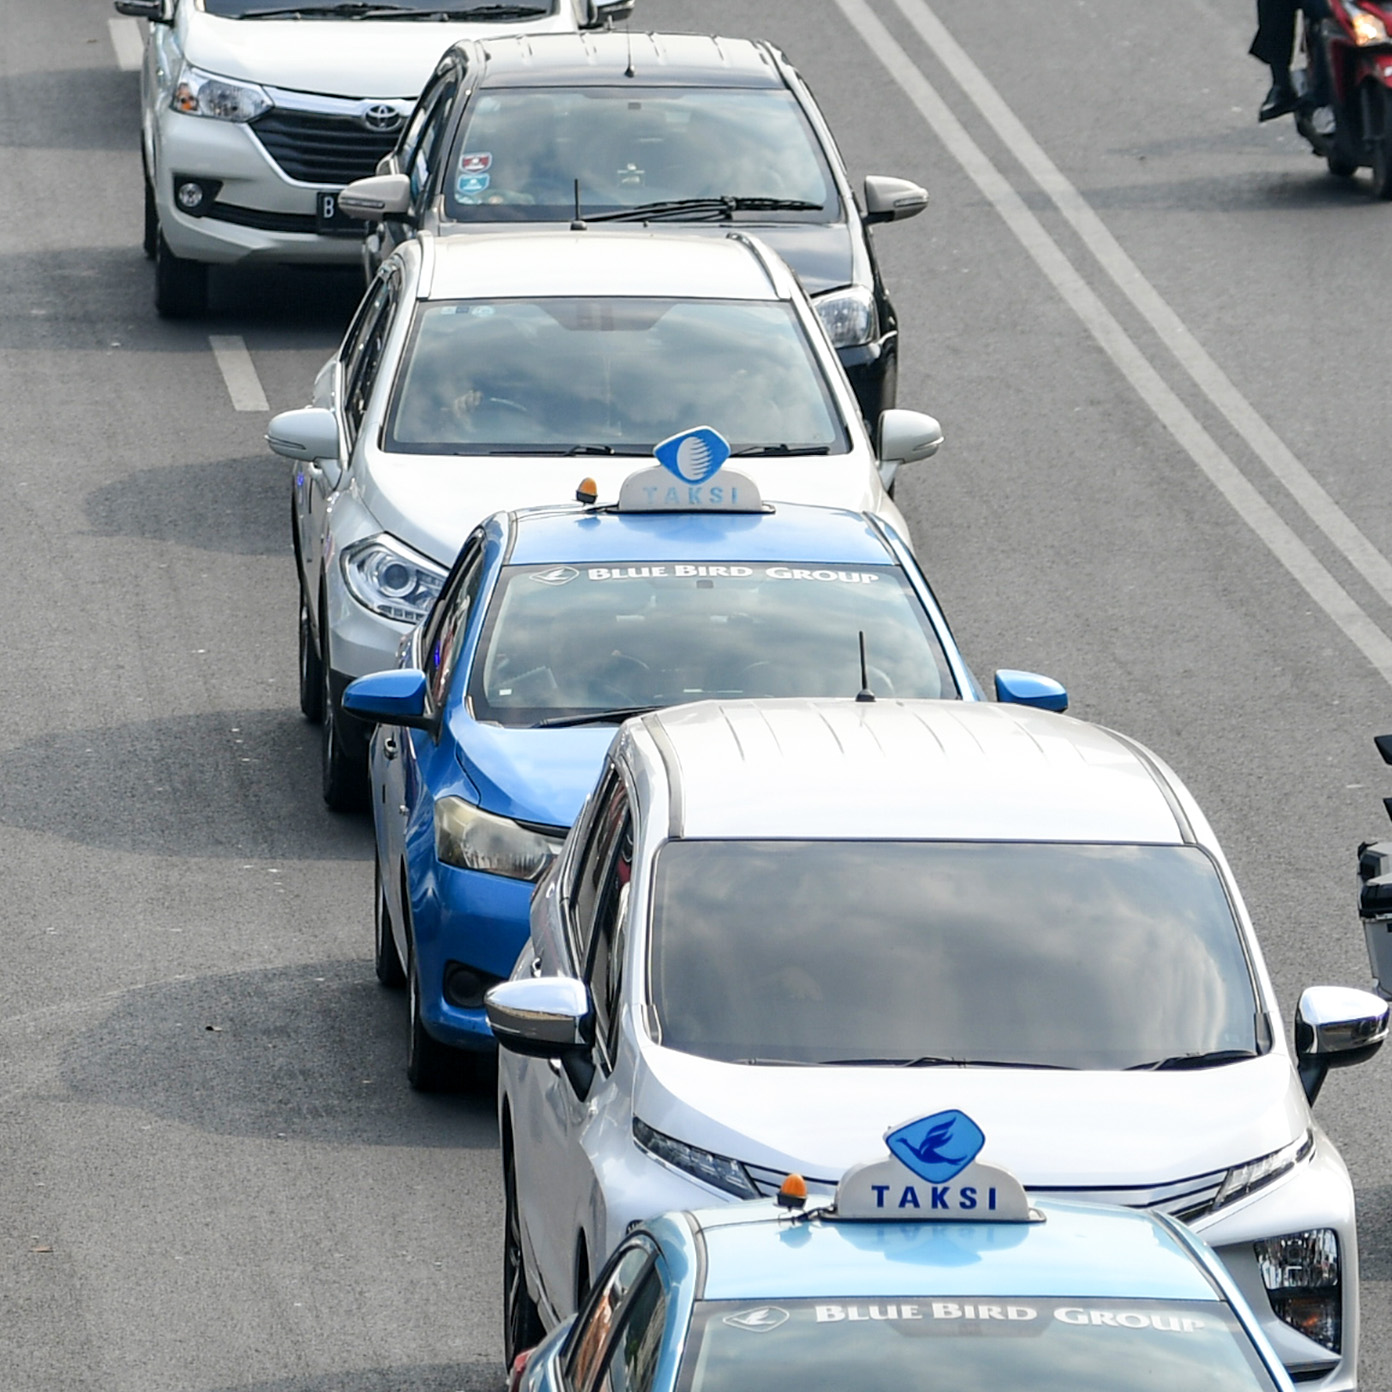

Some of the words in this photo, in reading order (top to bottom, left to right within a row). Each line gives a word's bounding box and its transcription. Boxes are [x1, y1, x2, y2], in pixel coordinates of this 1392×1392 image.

[323, 196, 335, 218] B
[642, 486, 739, 505] TAKSI
[587, 565, 672, 581] BLUE
[674, 564, 754, 579] BIRD
[766, 566, 880, 584] GROUP
[870, 1184, 997, 1210] TAKSI
[815, 1304, 924, 1324] BLUE
[932, 1302, 1039, 1322] BIRD
[1053, 1306, 1206, 1333] GROUP
